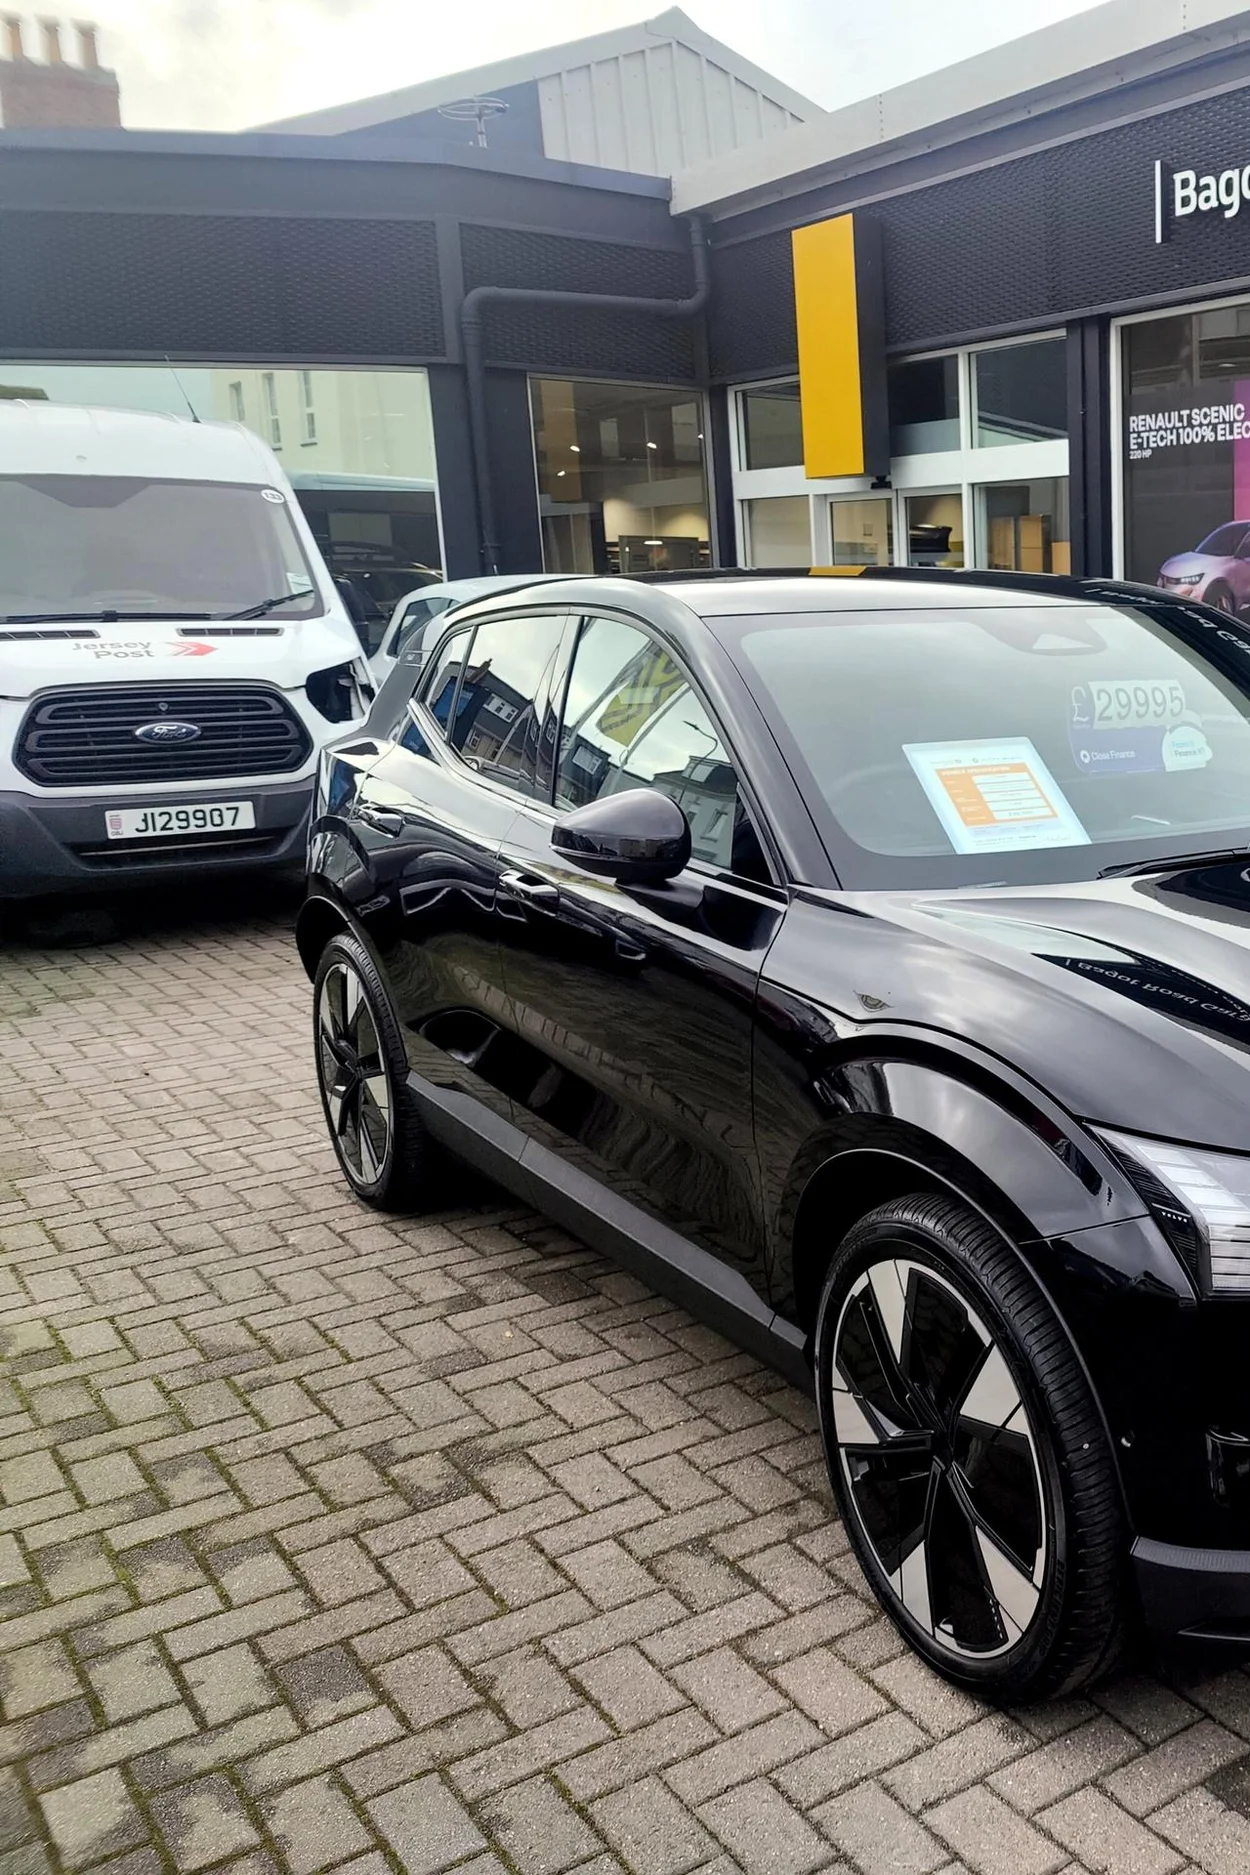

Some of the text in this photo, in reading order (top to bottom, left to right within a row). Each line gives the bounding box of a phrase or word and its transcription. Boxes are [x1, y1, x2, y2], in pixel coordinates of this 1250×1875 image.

[1129, 403, 1246, 432] RENAULT SCENIC
[1129, 429, 1177, 450] E-TECH
[1179, 423, 1216, 444] 100%
[1129, 449, 1152, 460] 220 HP
[73, 641, 151, 650] Jersey
[94, 649, 155, 659] Post
[152, 725, 188, 739] Ford
[1110, 750, 1137, 759] Finance
[135, 807, 239, 833] J129907
[1161, 1211, 1187, 1223] VOLVO
